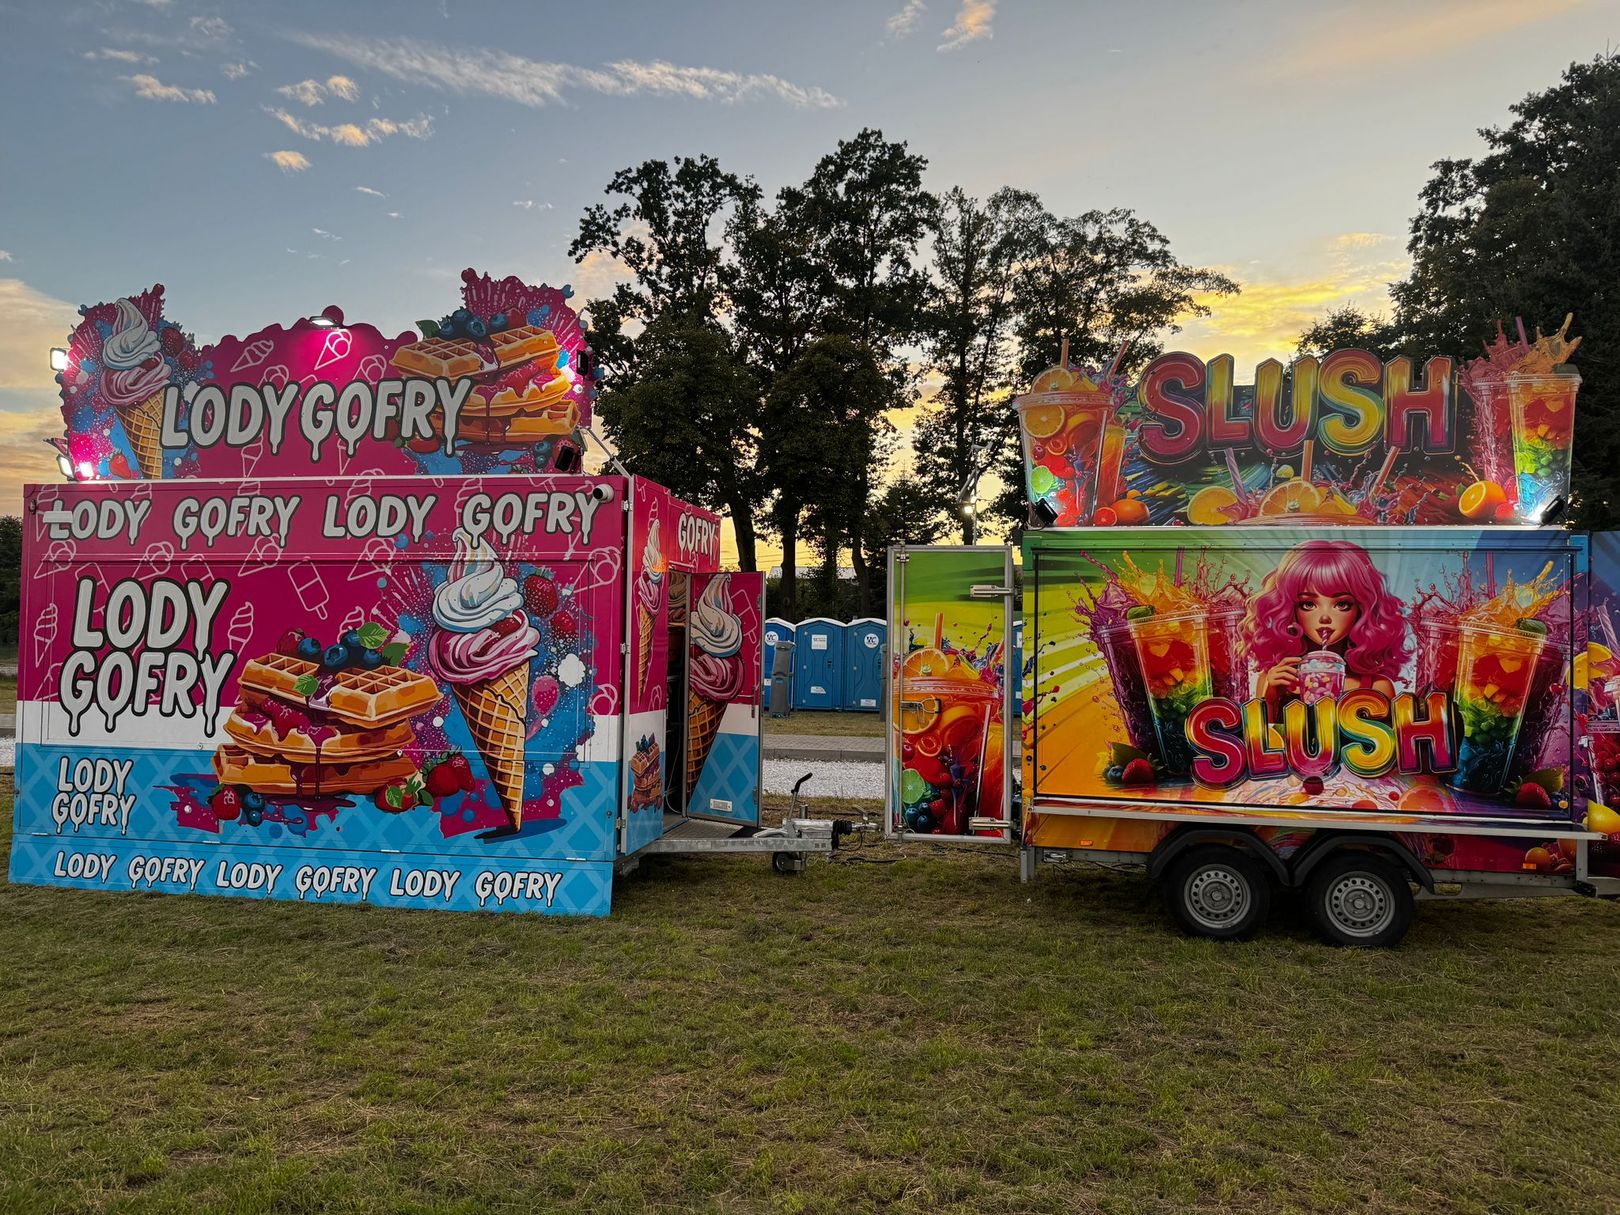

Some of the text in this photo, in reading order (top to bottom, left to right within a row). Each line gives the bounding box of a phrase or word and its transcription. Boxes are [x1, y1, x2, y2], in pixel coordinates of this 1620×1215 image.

[160, 376, 471, 461] LODY GOFRY
[1139, 350, 1456, 464] SLUSH
[47, 492, 600, 550] LODY GOFRY LODY GOFRY
[678, 512, 716, 566] GOFRY
[72, 578, 231, 661] LODY
[59, 650, 237, 737] GOFRY
[1184, 689, 1458, 790] SLUSH
[57, 756, 134, 796] LODY
[52, 793, 136, 834] GOFRY
[53, 851, 562, 907] LODY GOFRY LODY GOFRY LODY GOFRY
